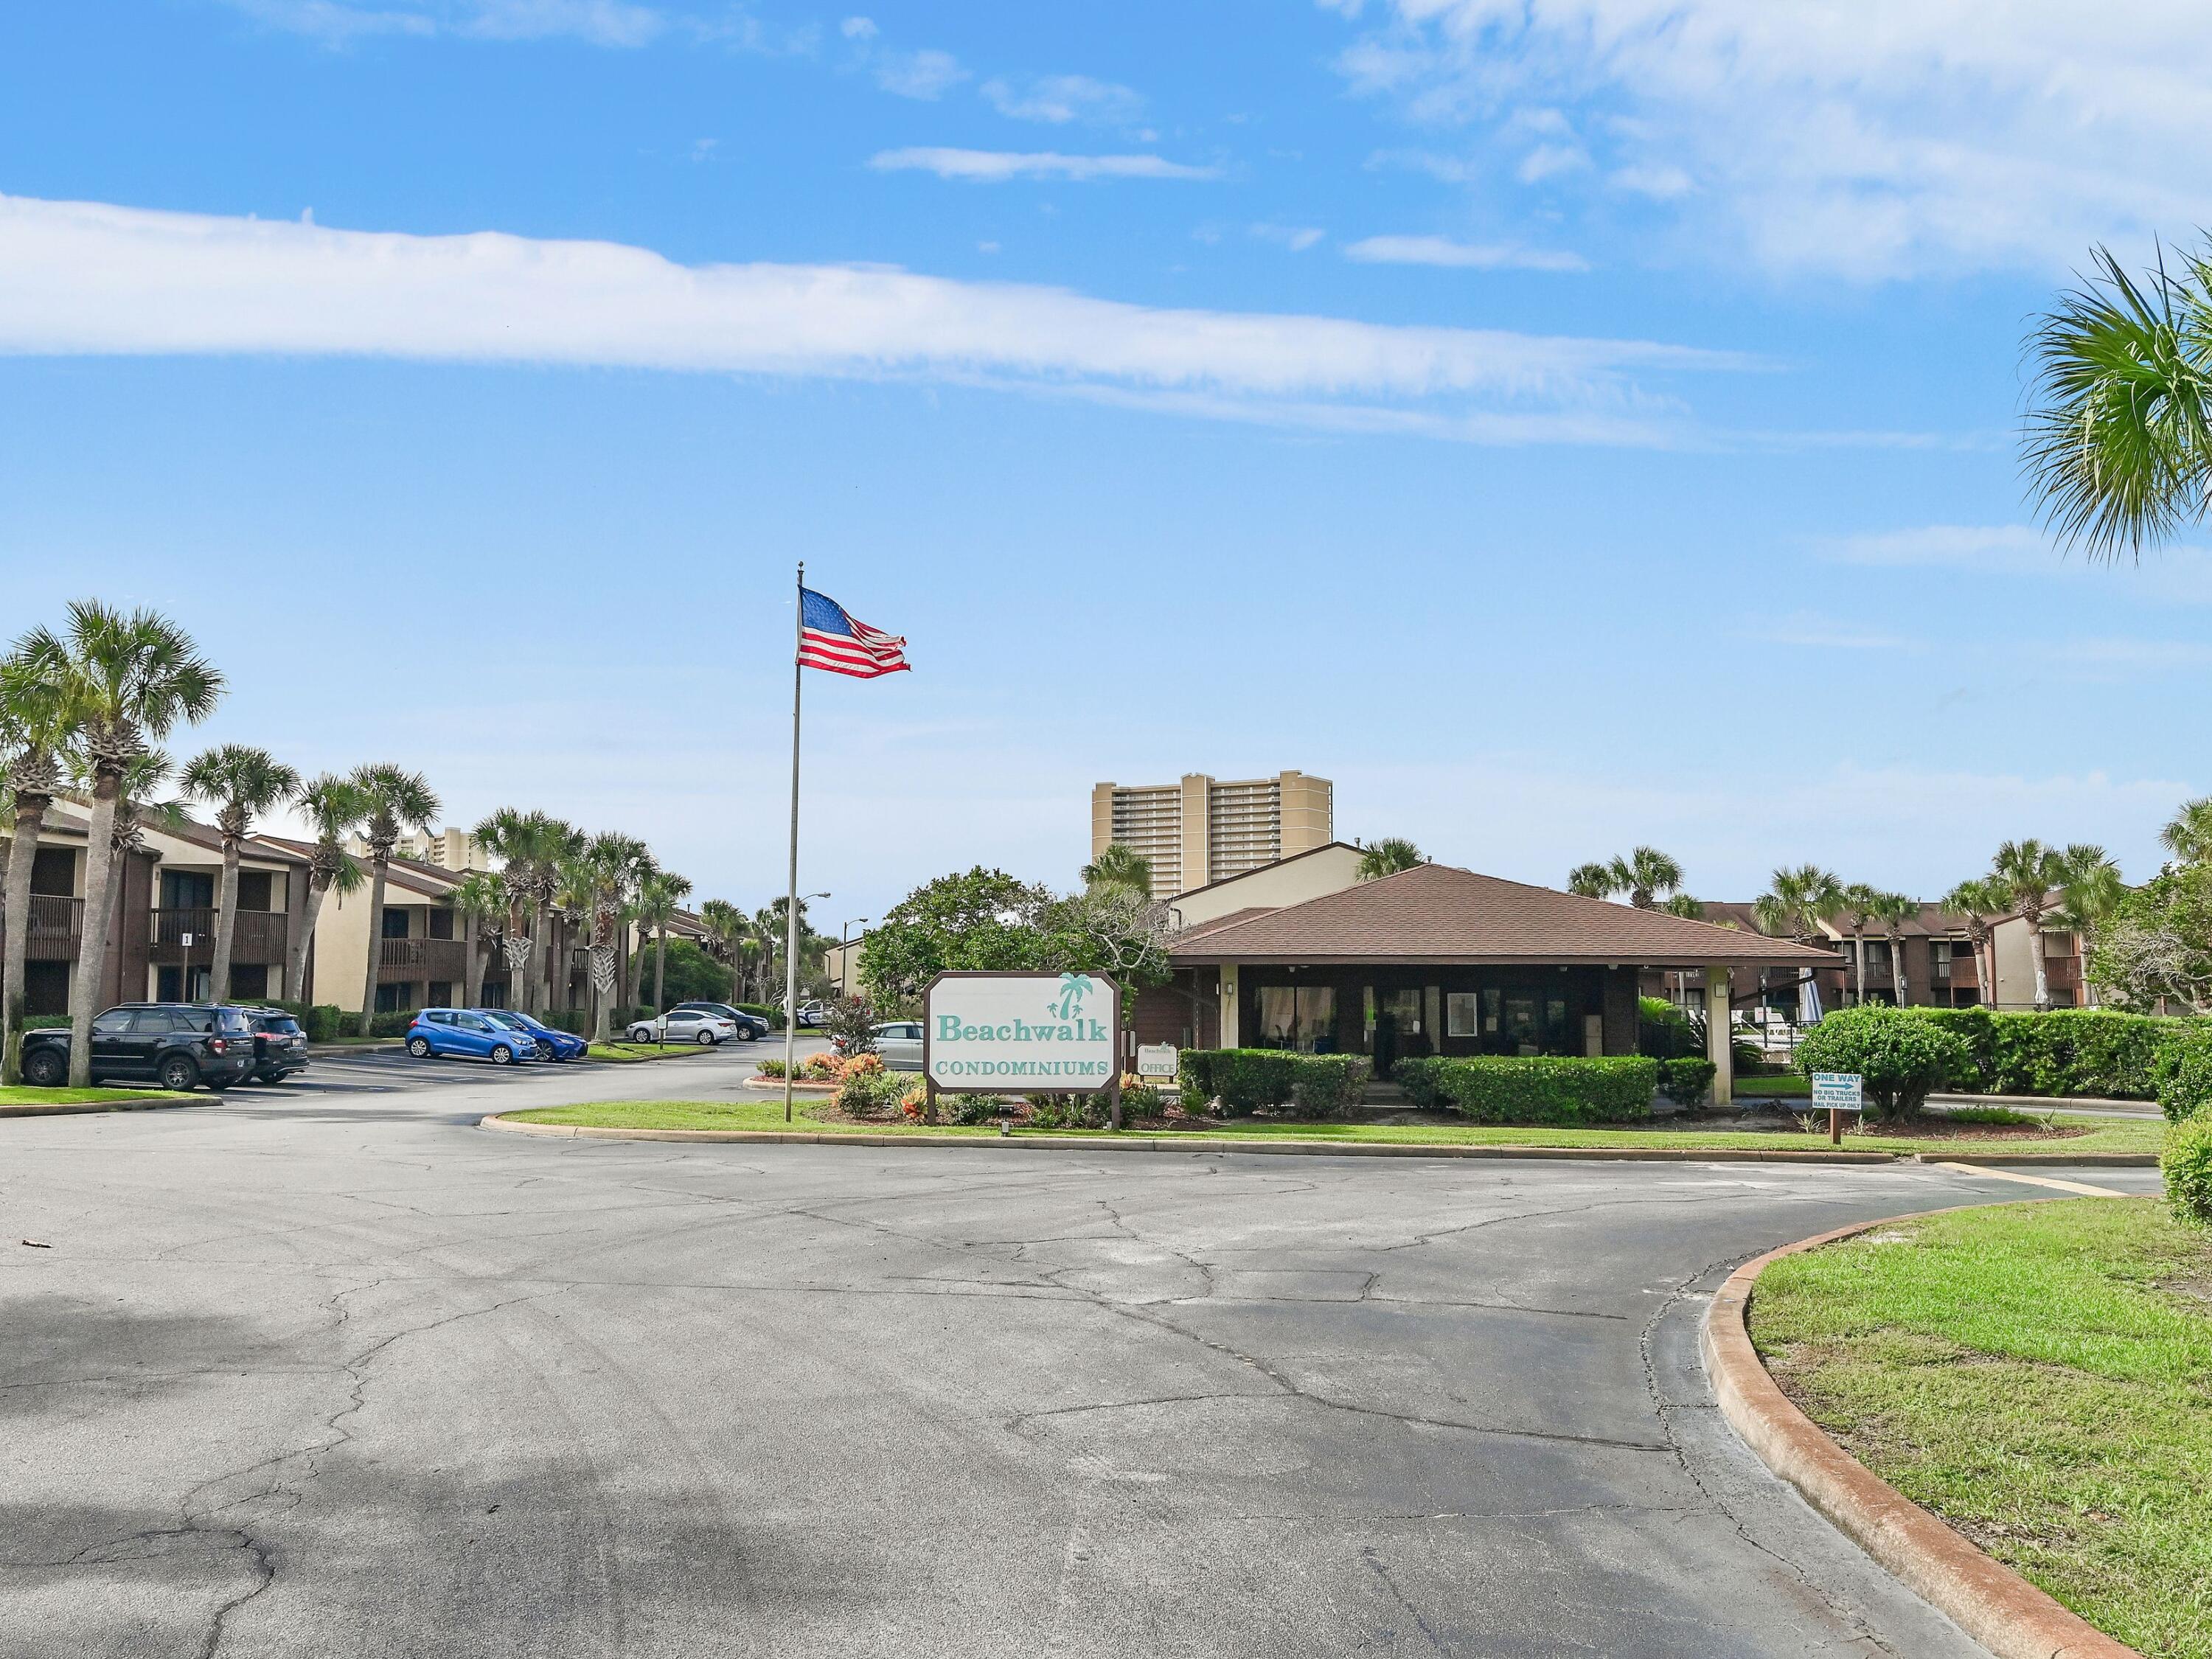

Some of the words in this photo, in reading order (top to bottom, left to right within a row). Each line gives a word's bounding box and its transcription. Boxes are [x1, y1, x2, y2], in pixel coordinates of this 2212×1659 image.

[936, 1015, 1108, 1042] Beachwalk
[935, 1061, 1108, 1075] CONDOMINIUMS
[1141, 1062, 1175, 1073] OFFICE
